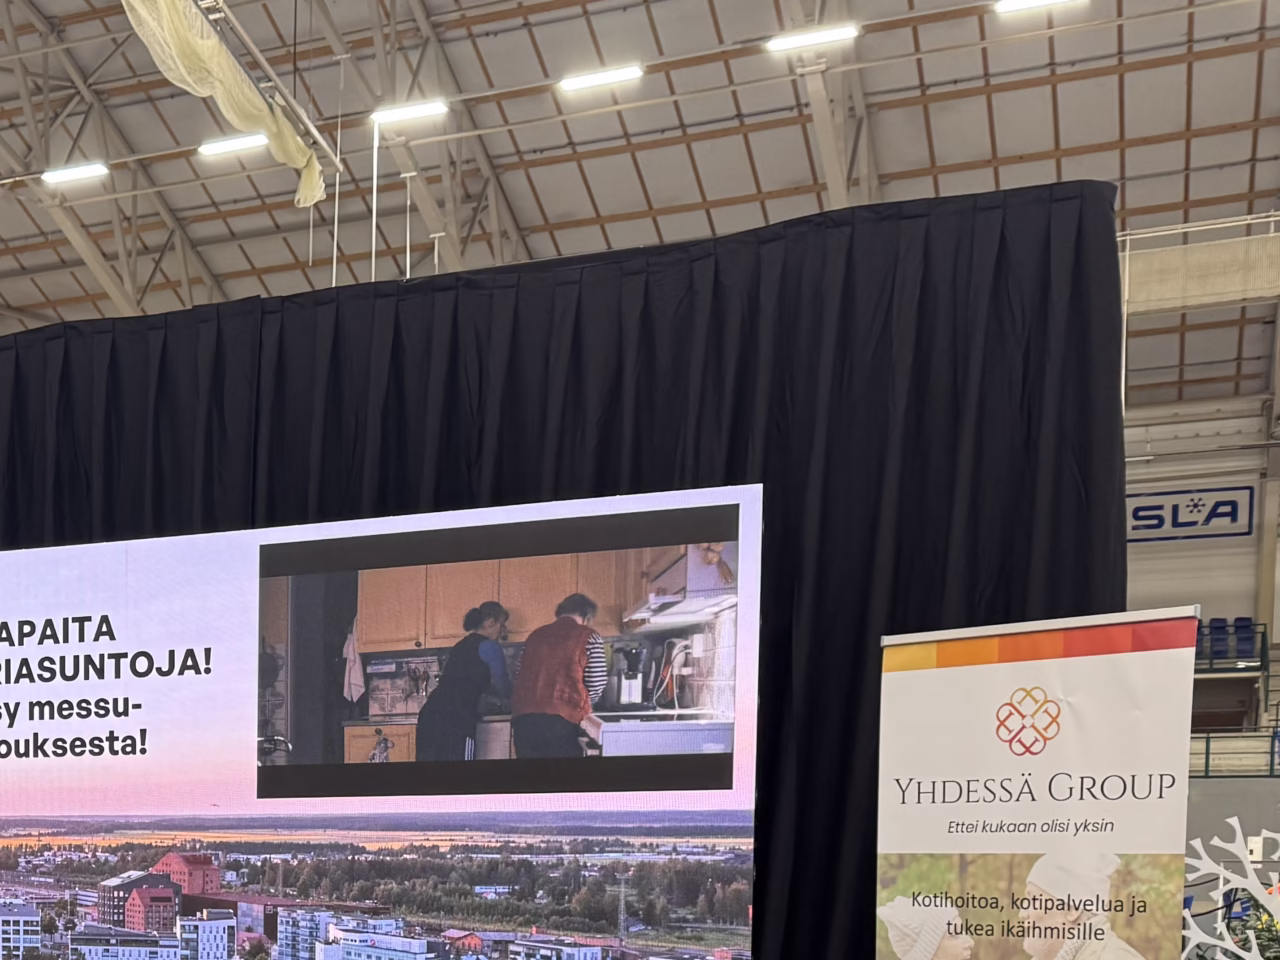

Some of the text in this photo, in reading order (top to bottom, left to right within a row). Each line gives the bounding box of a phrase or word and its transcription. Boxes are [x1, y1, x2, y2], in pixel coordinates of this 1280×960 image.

[27, 696, 142, 722] messu-
[893, 772, 1176, 805] YHDESSÄ GROUP
[947, 818, 1115, 837] Ettei kukaan olisi yksin
[911, 891, 1147, 917] Kotihoitoa, kotipalvelua ja
[946, 919, 1106, 942] tukea ikäihmisille
